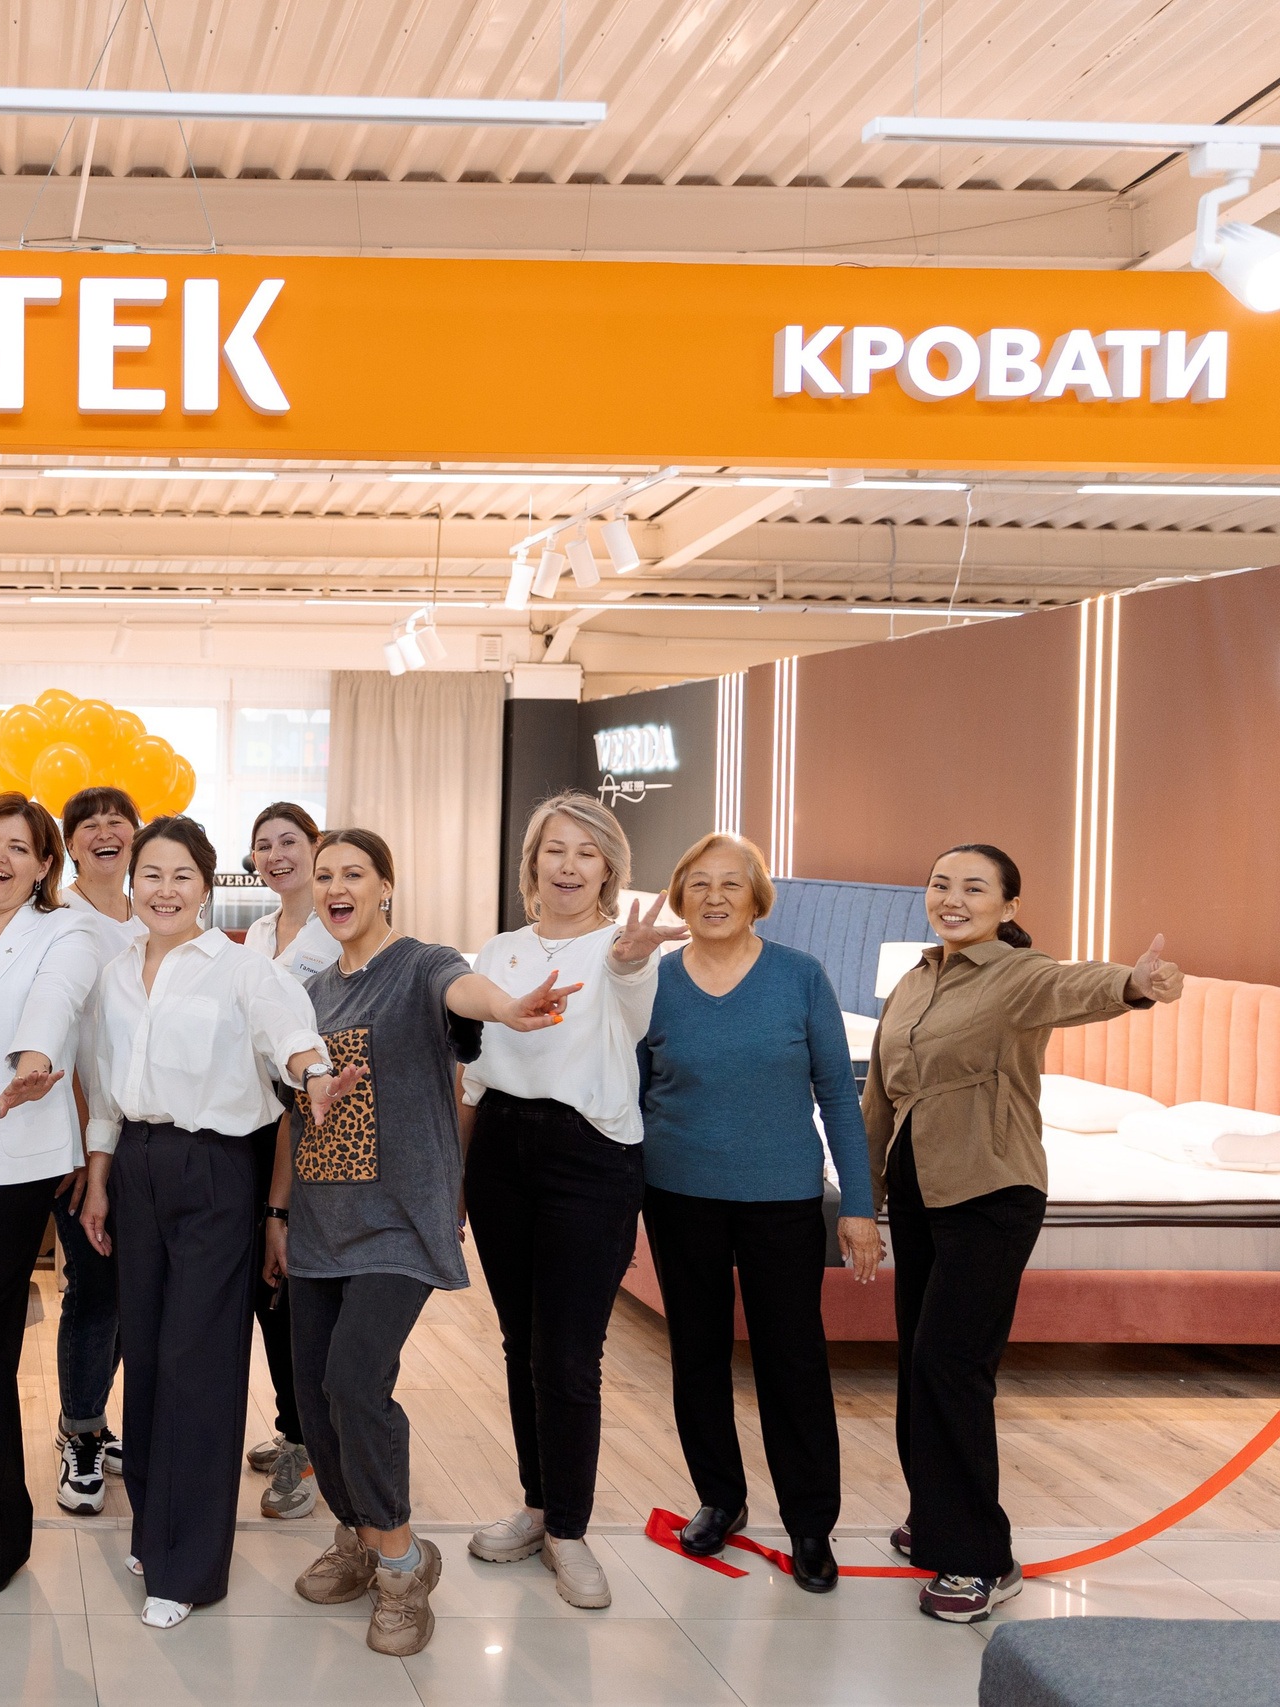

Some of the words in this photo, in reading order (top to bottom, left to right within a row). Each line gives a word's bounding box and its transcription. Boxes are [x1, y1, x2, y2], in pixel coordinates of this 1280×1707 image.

[774, 325, 1228, 402] КРОВАТИ
[593, 725, 674, 771] VERDA
[621, 780, 634, 792] SINCE
[217, 875, 263, 886] VERDA
